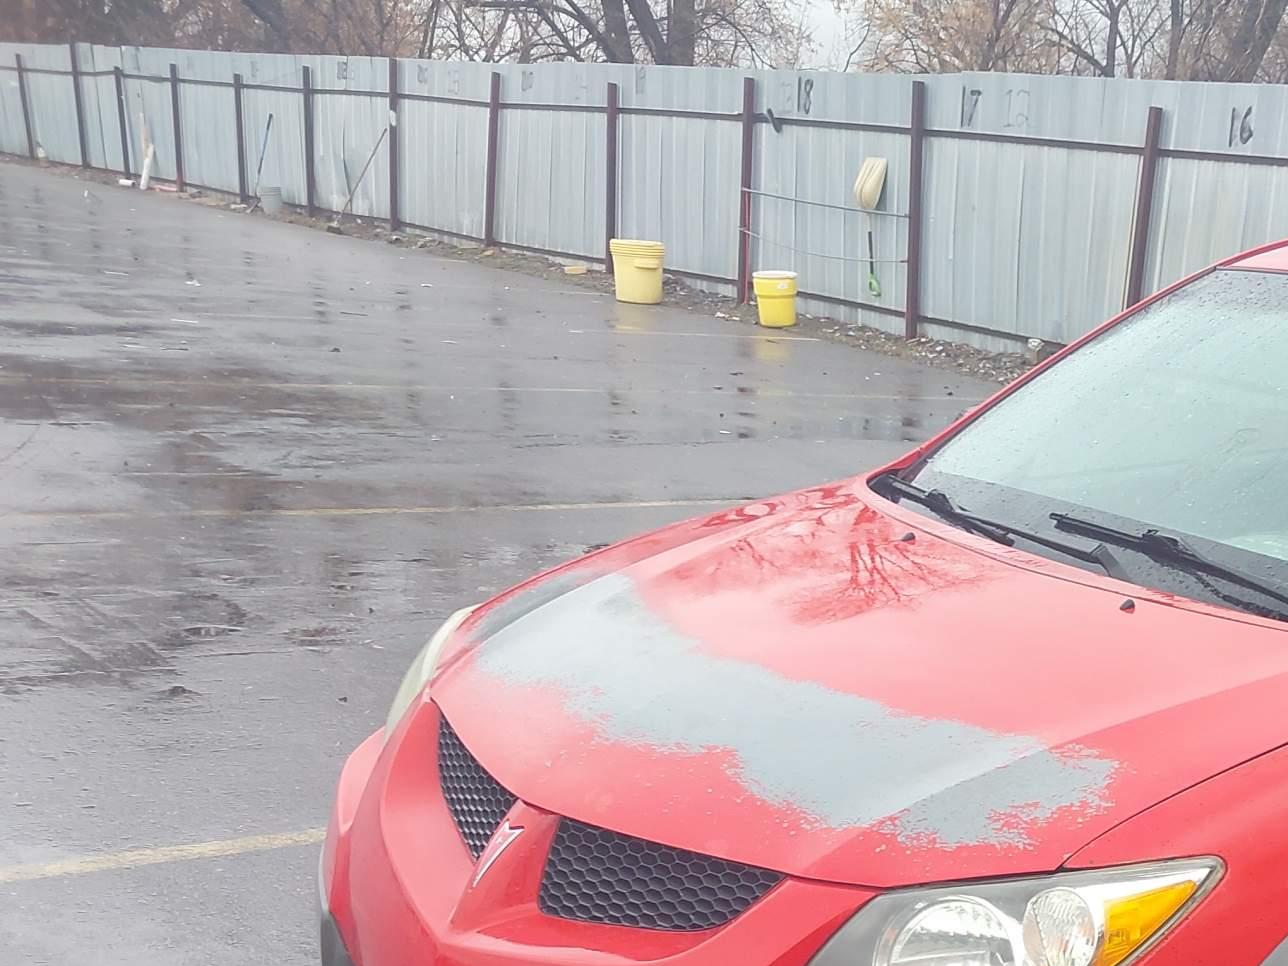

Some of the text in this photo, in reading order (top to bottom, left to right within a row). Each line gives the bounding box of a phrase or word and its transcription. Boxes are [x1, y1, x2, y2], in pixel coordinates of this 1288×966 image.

[797, 76, 814, 115] 18
[960, 86, 982, 128] 17
[1228, 105, 1254, 148] 16
